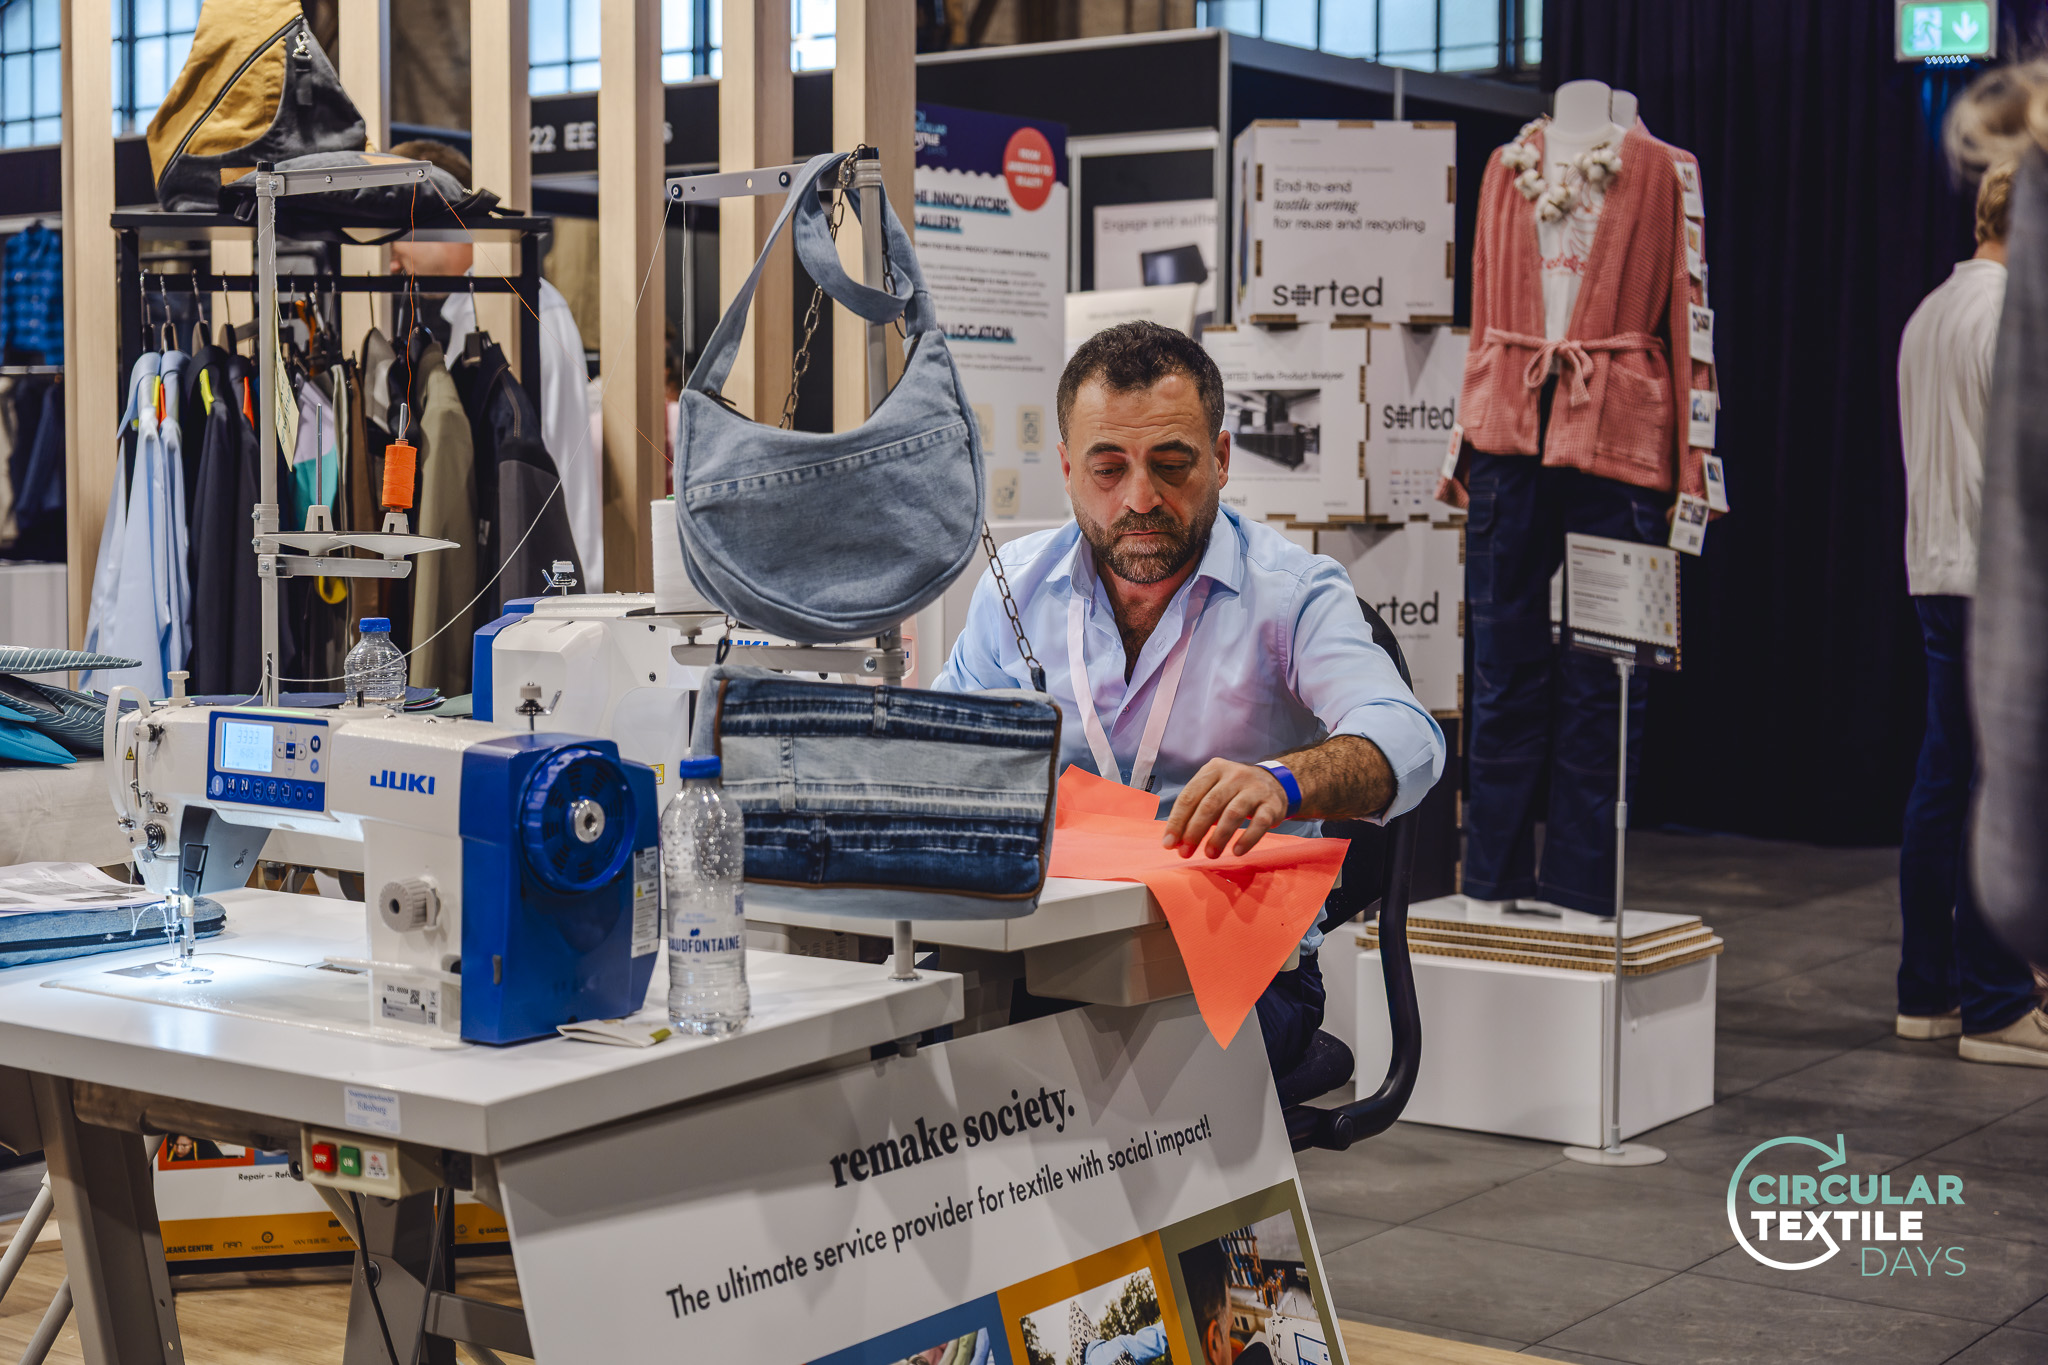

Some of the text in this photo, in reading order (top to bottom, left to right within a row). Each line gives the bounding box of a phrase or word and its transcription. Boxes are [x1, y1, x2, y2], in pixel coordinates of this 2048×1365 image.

[1273, 277, 1383, 306] sorted
[1383, 397, 1455, 430] sorted
[370, 769, 435, 795] JUKI
[829, 1087, 1075, 1188] remake society.
[314, 1154, 327, 1164] OFF
[343, 1158, 354, 1167] ON
[238, 1172, 265, 1182] Repair
[667, 1114, 1212, 1318] The ultimate service provider for textile with social impact!
[165, 1244, 214, 1254] JEANS CENTRE
